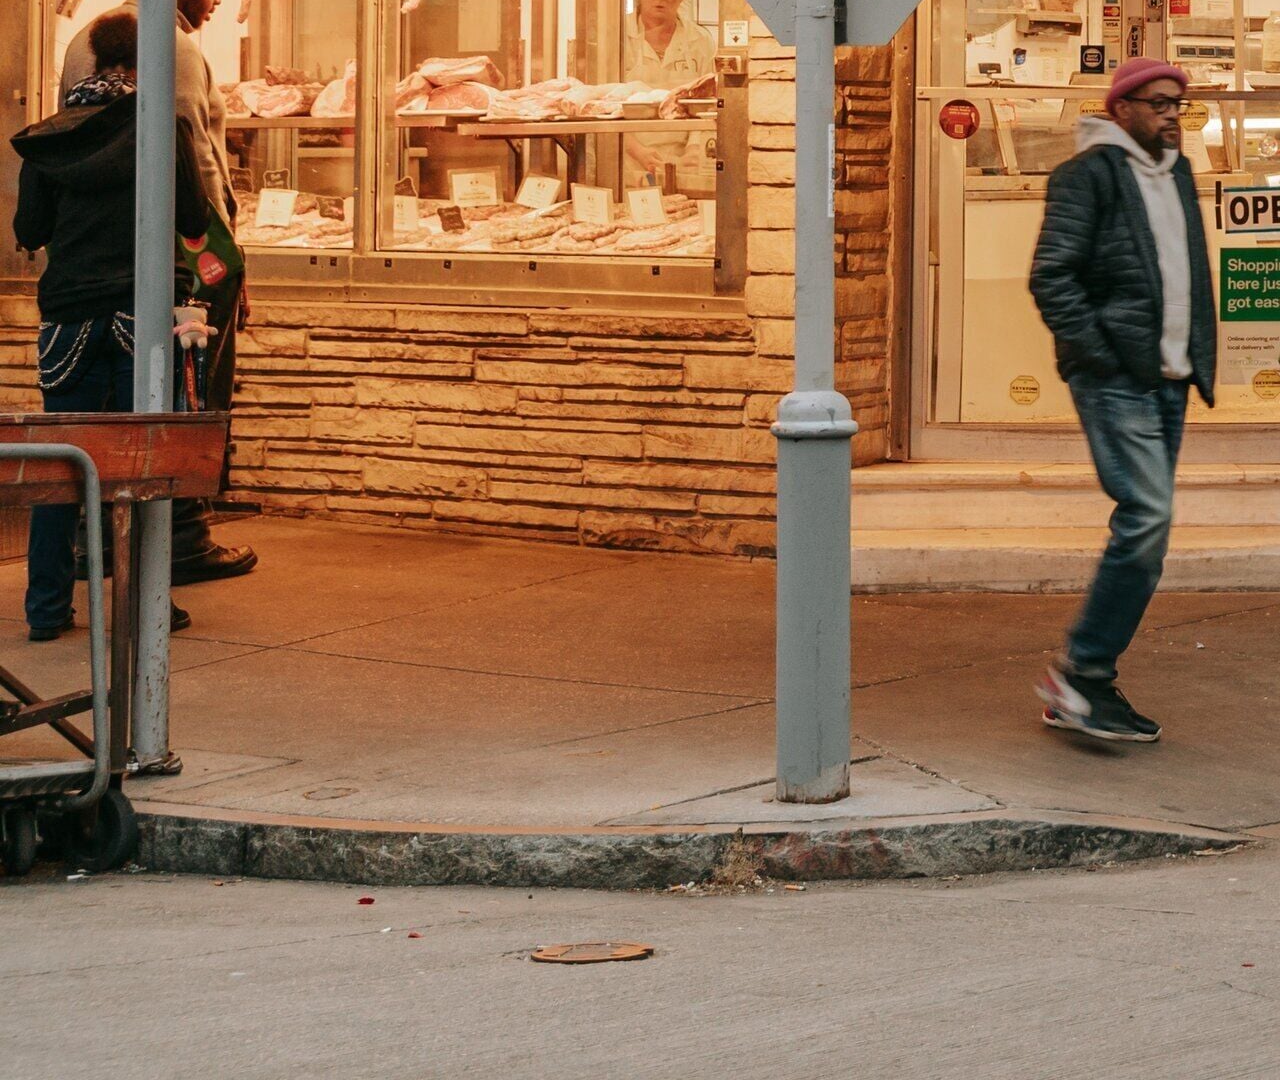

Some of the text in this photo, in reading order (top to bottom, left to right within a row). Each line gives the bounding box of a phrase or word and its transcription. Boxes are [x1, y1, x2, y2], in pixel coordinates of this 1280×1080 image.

[1131, 26, 1139, 56] PUSH
[1227, 277, 1260, 290] here
[1227, 296, 1251, 312] got
